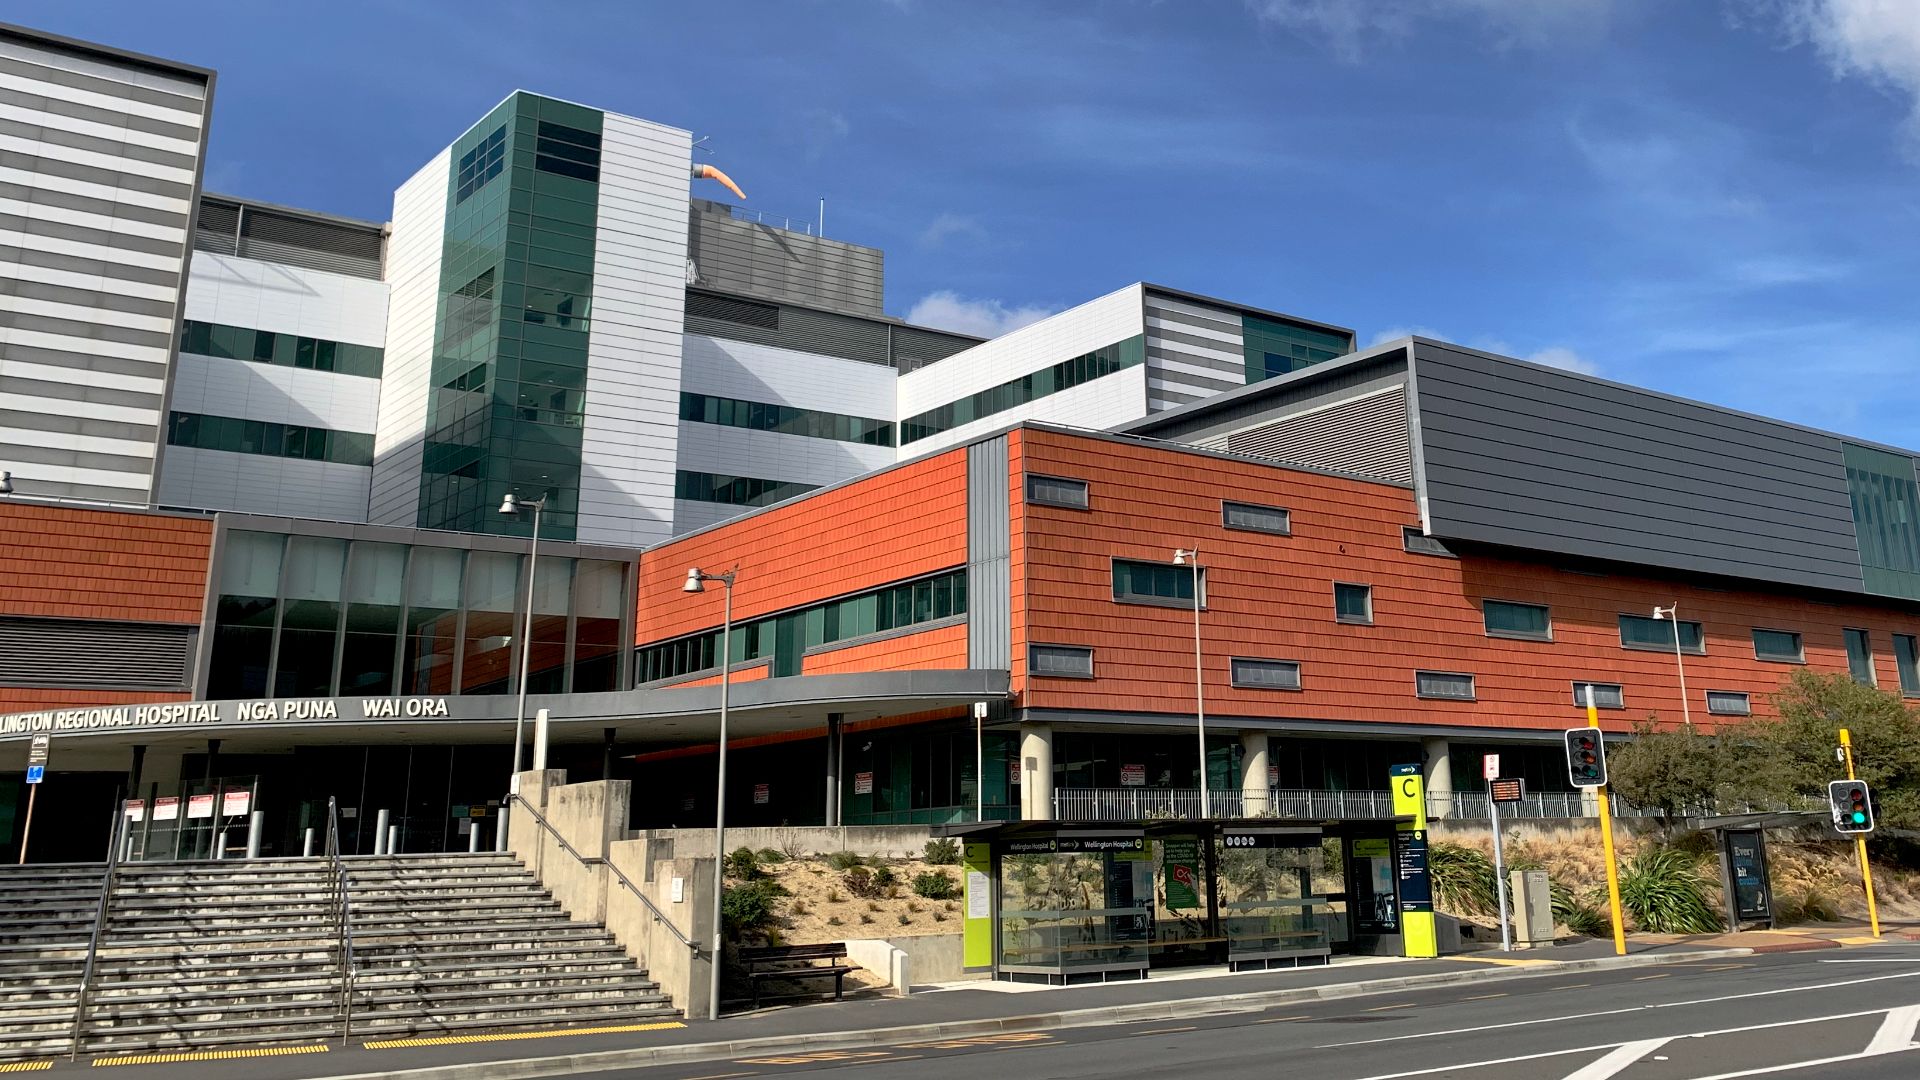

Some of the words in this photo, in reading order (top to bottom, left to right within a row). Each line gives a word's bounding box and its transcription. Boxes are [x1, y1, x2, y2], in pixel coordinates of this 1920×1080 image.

[0, 713, 54, 733] LINGTON
[55, 708, 131, 729] REGIONAL
[135, 703, 220, 724] HOSPITAL
[237, 702, 278, 720] NGA
[283, 700, 337, 718] PUNA
[362, 699, 401, 717] WAI
[406, 699, 448, 716] ORA
[1403, 778, 1415, 798] C
[1010, 842, 1031, 851] Wellington
[1032, 842, 1048, 850] Hospital
[1084, 840, 1112, 849] Wellington
[1113, 840, 1133, 849] Hospital
[966, 846, 975, 858] C
[1734, 847, 1754, 858] Every
[1737, 867, 1747, 877] bit
